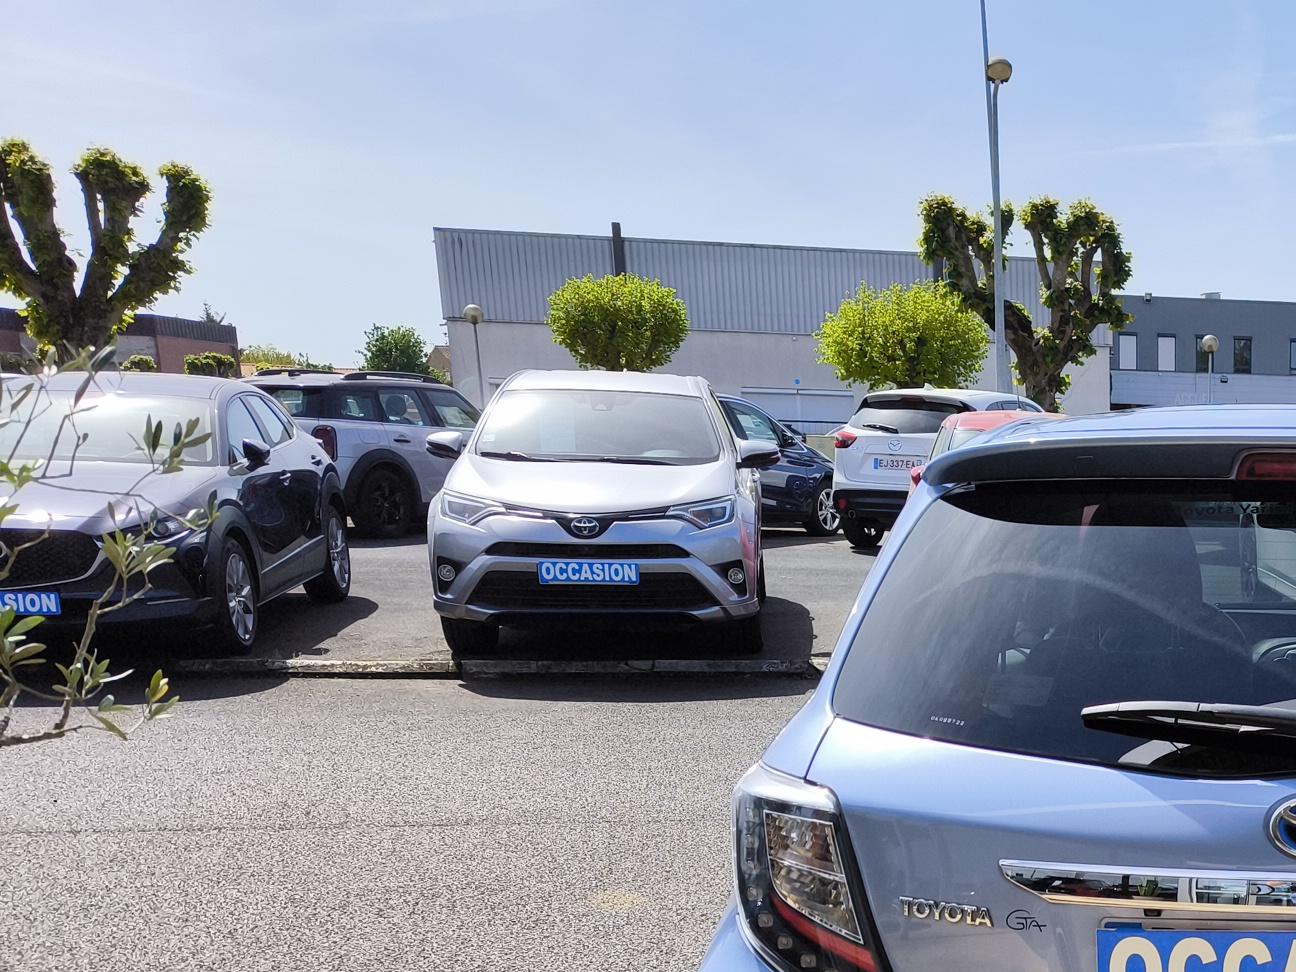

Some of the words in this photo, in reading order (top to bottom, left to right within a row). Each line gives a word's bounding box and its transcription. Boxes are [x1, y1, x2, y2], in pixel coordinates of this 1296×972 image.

[541, 562, 637, 581] OCCASION
[0, 593, 57, 612] SION
[899, 896, 994, 928] TOYOTA
